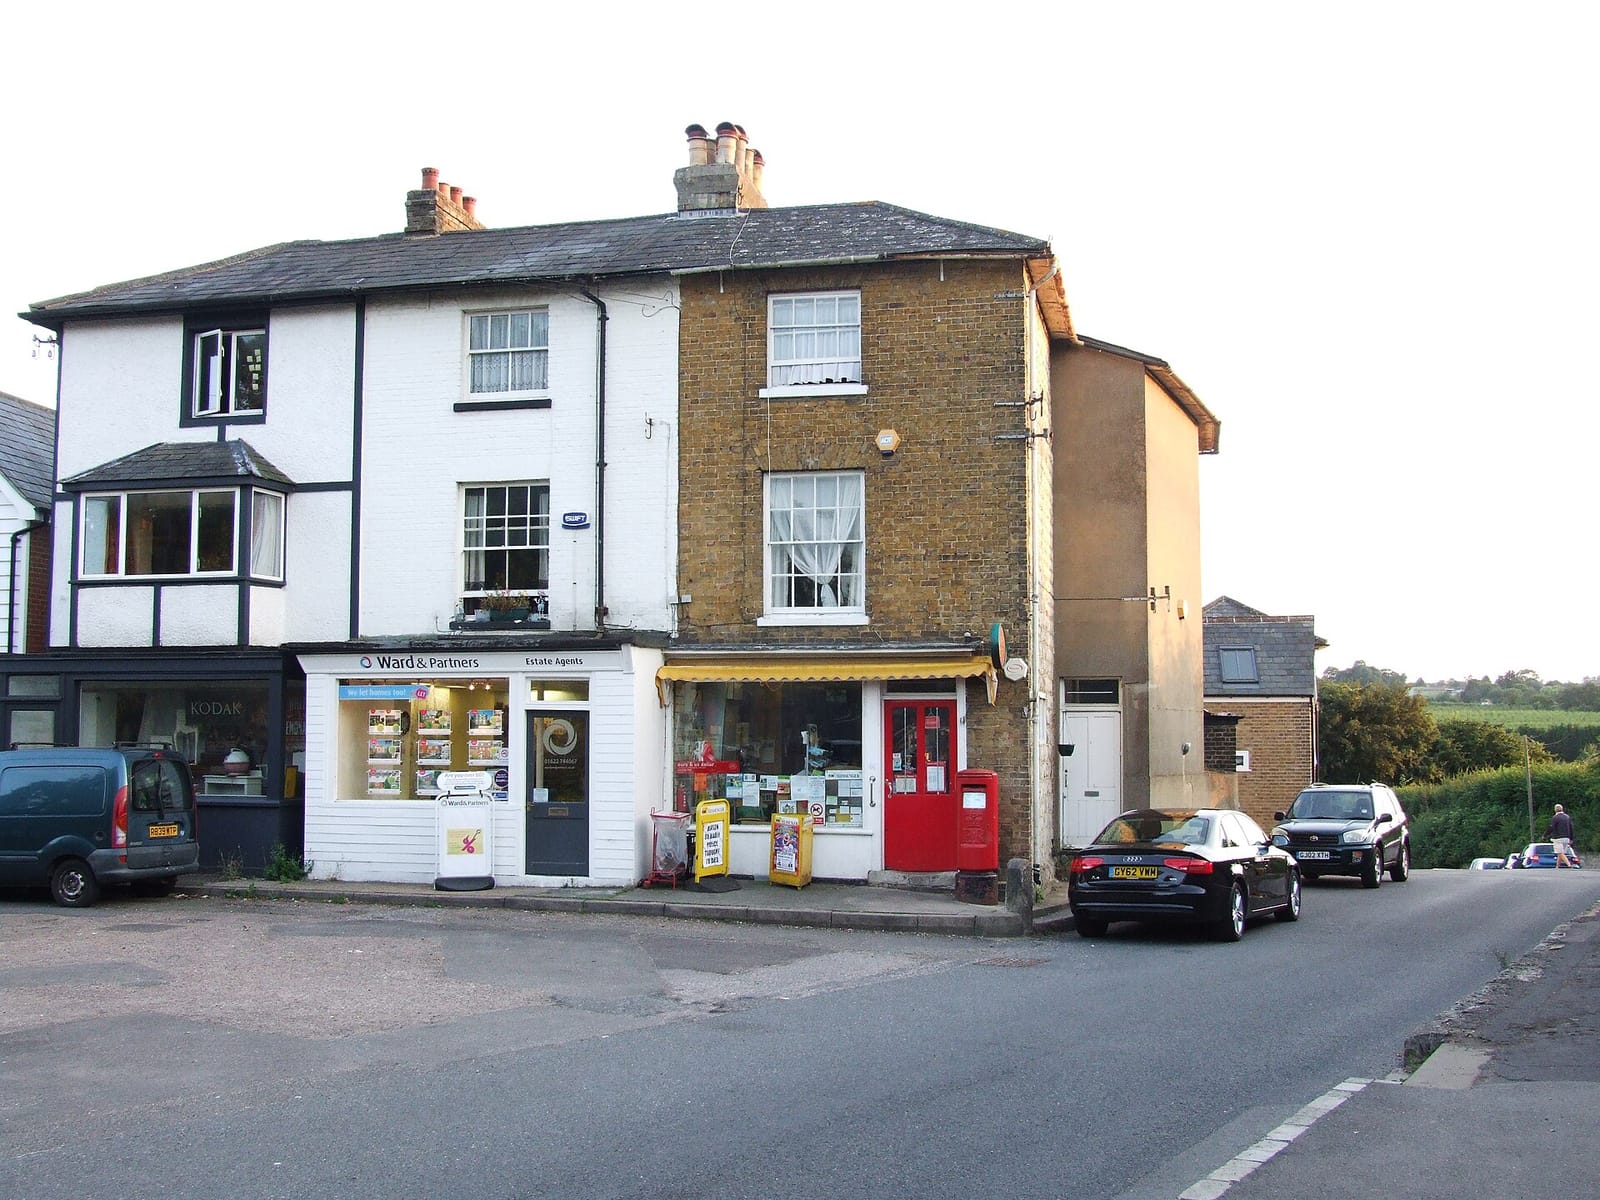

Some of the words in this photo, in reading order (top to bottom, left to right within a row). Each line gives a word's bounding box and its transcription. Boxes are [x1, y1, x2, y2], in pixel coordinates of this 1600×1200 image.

[377, 655, 414, 669] Ward
[416, 657, 427, 669] &
[429, 657, 479, 669] Partners
[525, 657, 553, 665] Estate
[555, 657, 583, 667] Agents
[359, 688, 368, 696] let
[369, 688, 391, 696] homes
[393, 688, 406, 696] too!
[417, 690, 427, 698] LET
[191, 702, 241, 715] KODAK
[1114, 867, 1137, 877] GY62
[1139, 867, 1156, 877] VWM
